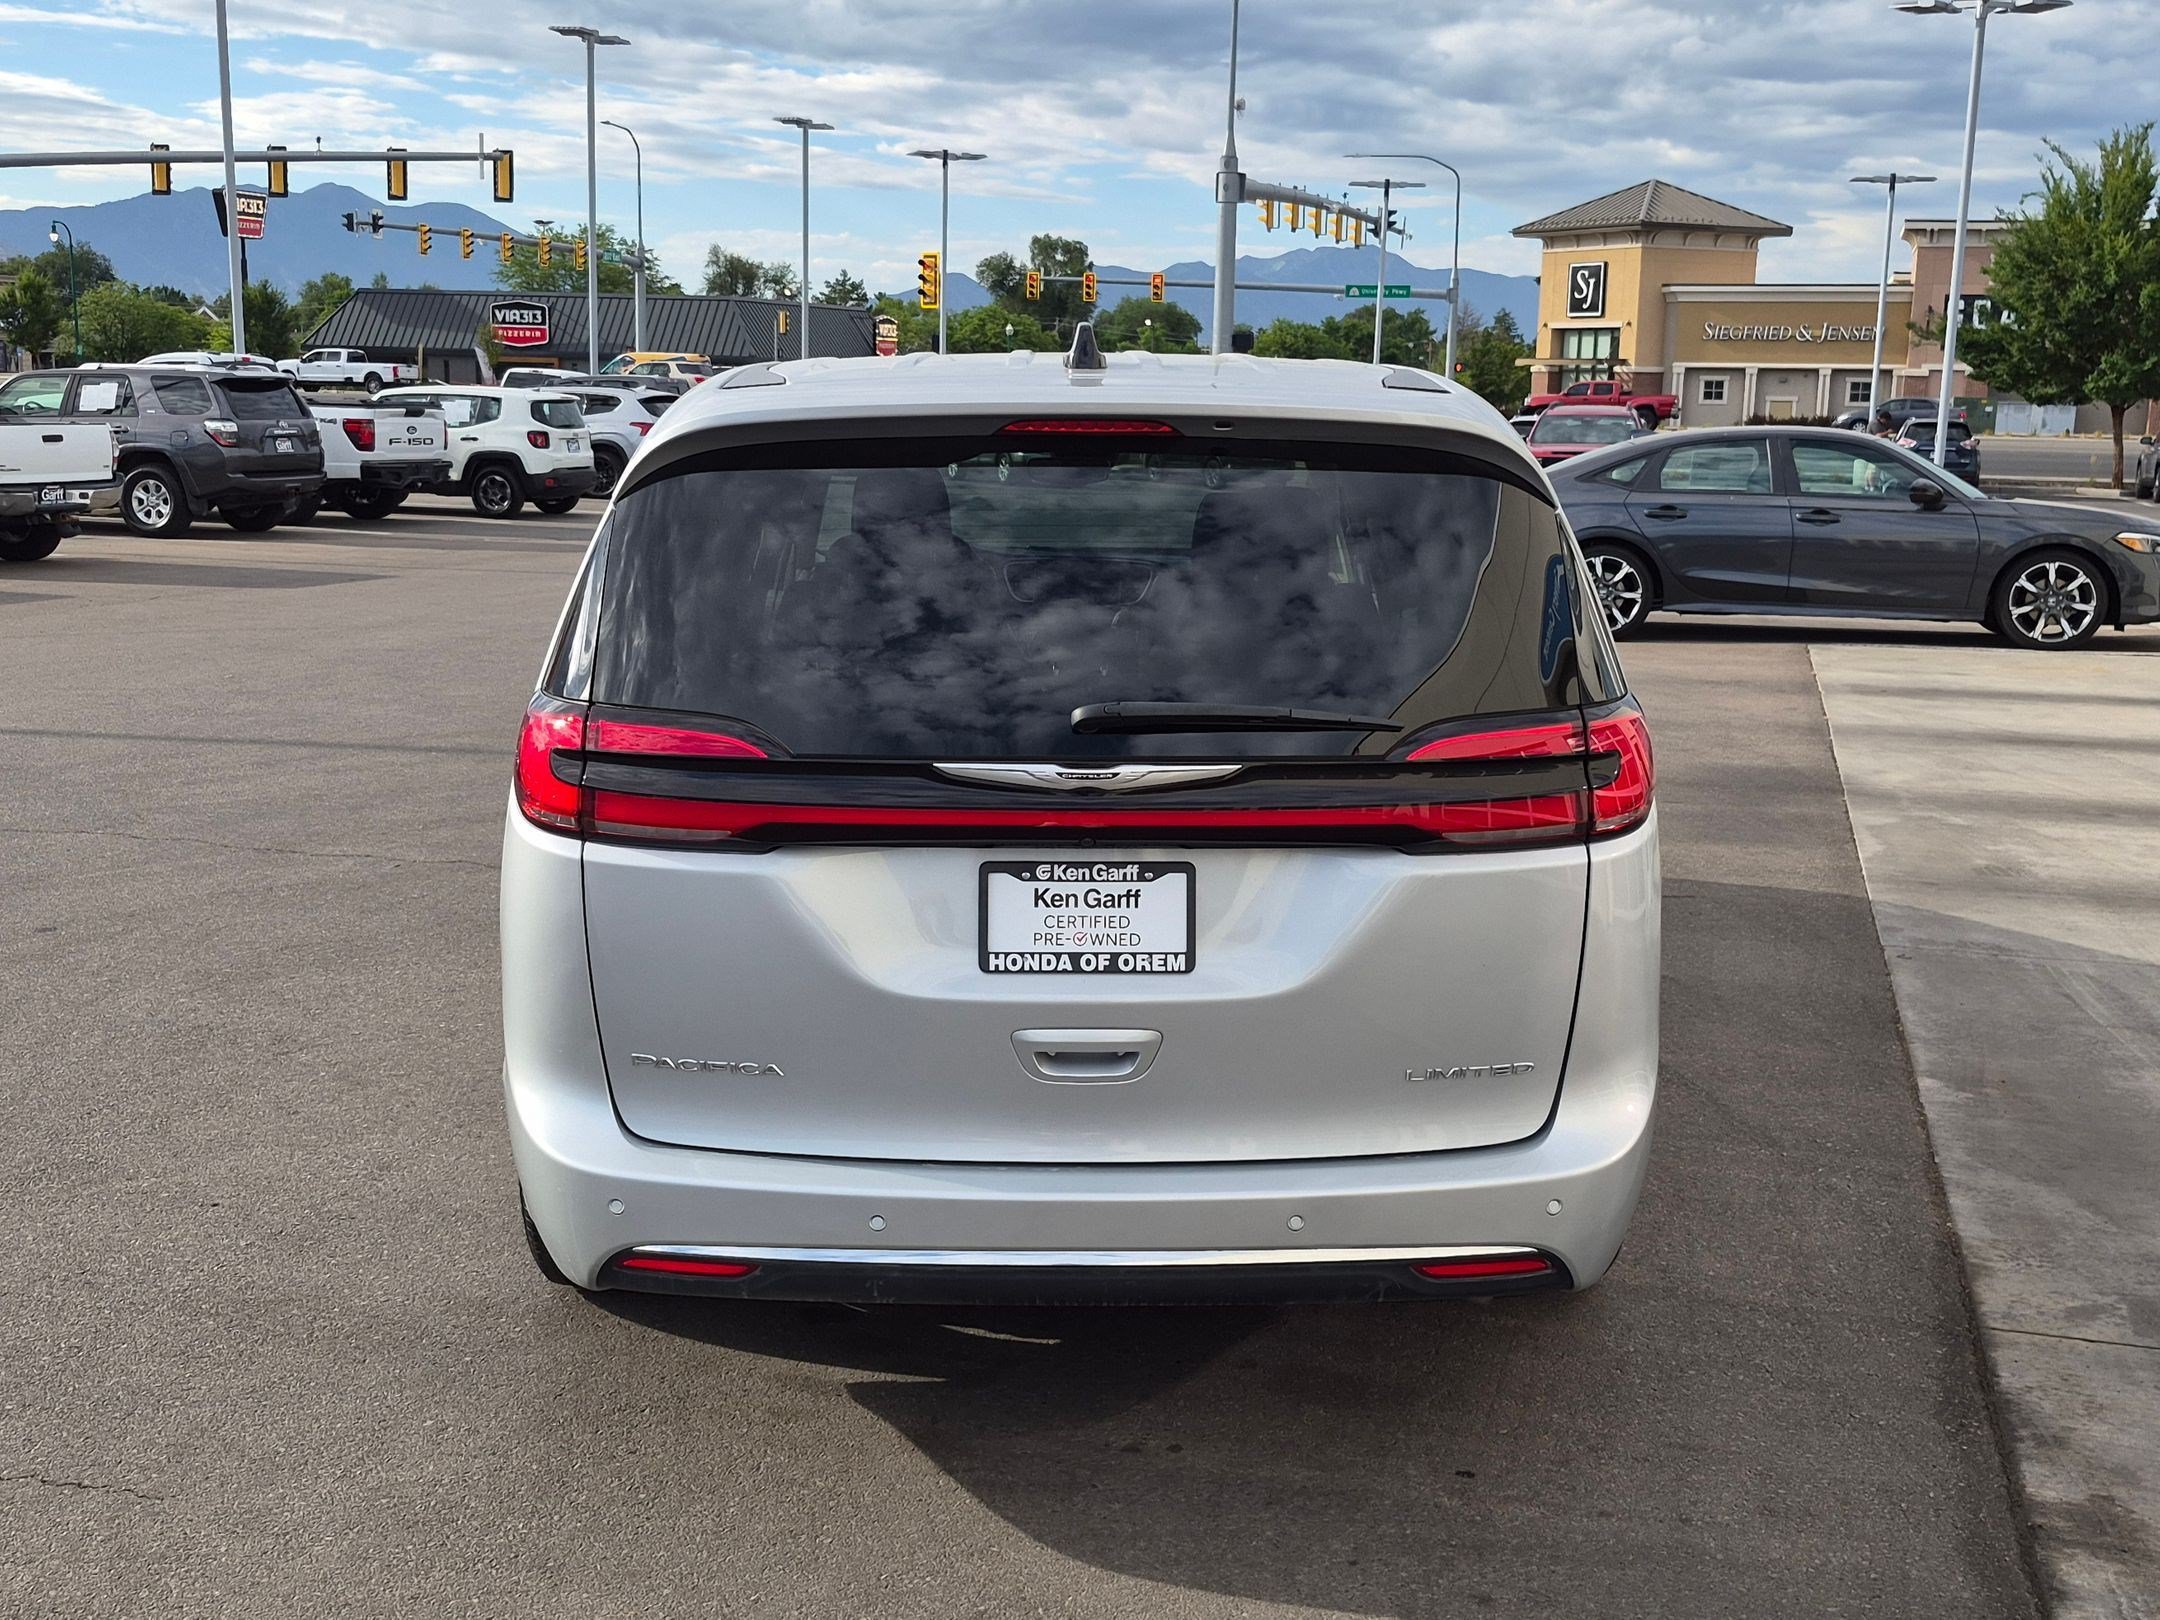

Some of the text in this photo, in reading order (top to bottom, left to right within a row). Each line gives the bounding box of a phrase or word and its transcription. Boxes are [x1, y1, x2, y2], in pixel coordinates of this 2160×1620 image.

[235, 197, 264, 214] IA313
[1574, 269, 1596, 309] SJ
[1702, 321, 1792, 341] SIEGFRIED
[1795, 323, 1813, 342] &
[388, 437, 434, 446] F-150
[1053, 864, 1140, 881] Ken Garff
[1033, 887, 1141, 909] Ken Garff
[1043, 915, 1131, 929] CERTIFIED
[988, 953, 1186, 972] HONDA OF OREM
[631, 1053, 785, 1077] PACIFICA
[1405, 1062, 1535, 1081] LIMITED
